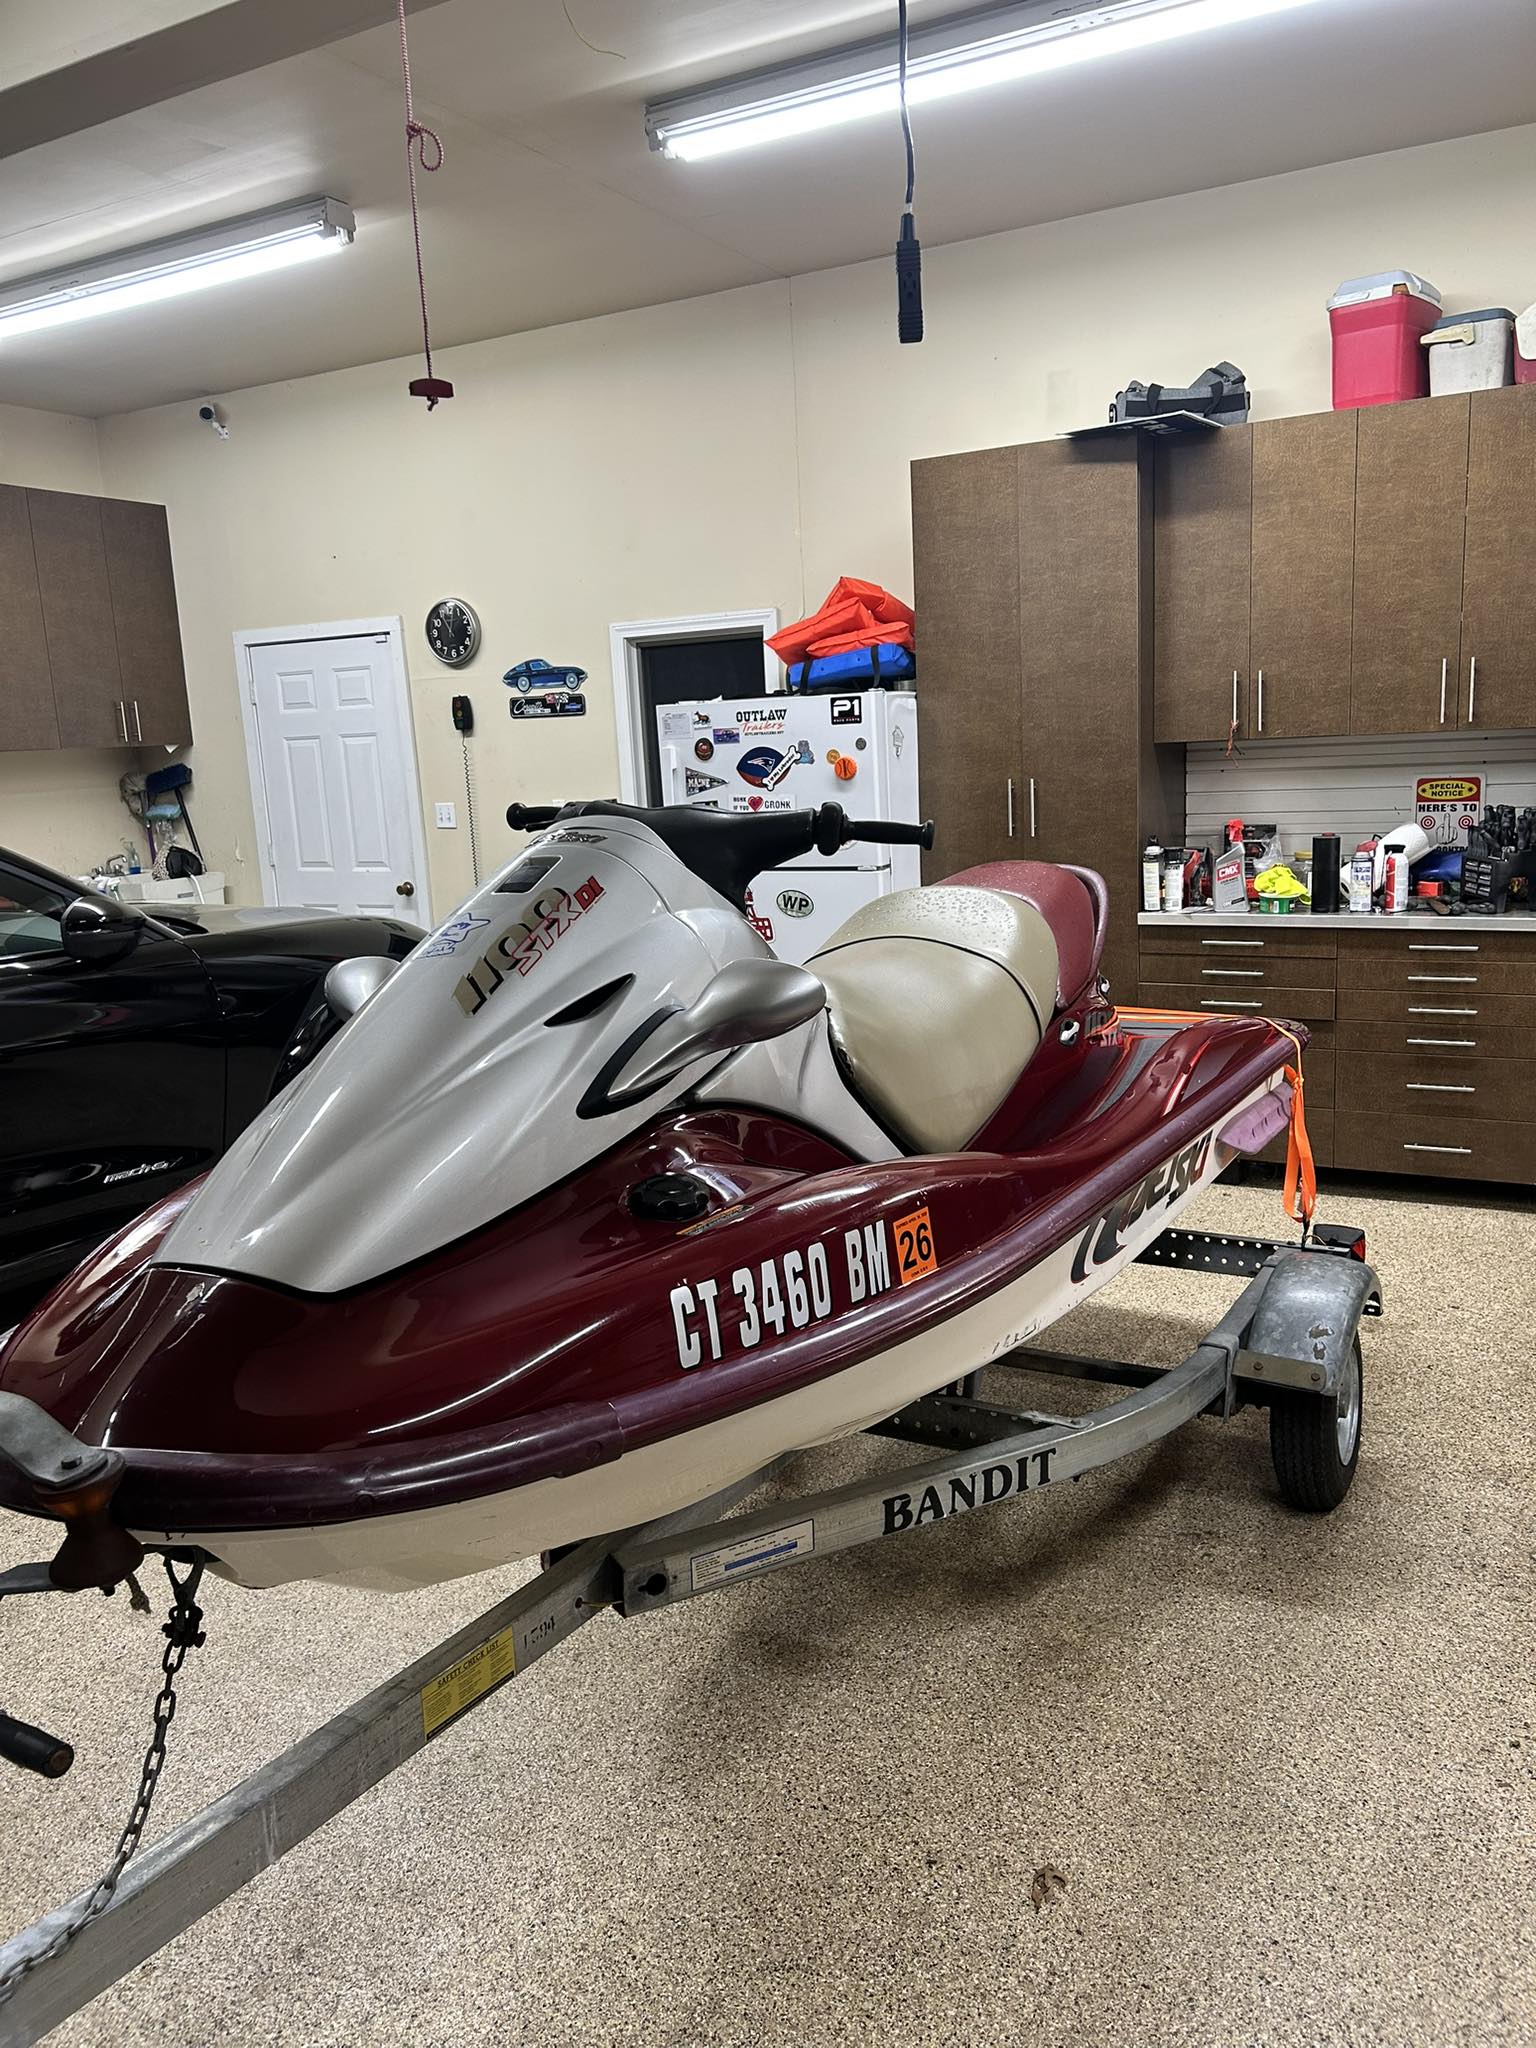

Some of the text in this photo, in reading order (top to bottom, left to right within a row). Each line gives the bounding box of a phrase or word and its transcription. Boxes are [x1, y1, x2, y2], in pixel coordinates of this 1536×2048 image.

[432, 628, 438, 638] 9
[466, 626, 472, 635] 3
[436, 640, 442, 649] 8
[464, 637, 470, 646] 4
[442, 646, 448, 655] 7
[451, 649, 457, 658] 6
[459, 646, 465, 655] 5
[832, 699, 860, 718] P1
[736, 709, 788, 723] OUTLAW
[742, 720, 784, 733] Trailers
[687, 777, 711, 788] MAINE
[1429, 783, 1466, 791] SPECIAL
[1431, 789, 1464, 797] NOTICE
[764, 800, 792, 810] GRONK
[1418, 803, 1477, 813] HERE'S TO
[1218, 864, 1239, 878] CMX
[573, 875, 608, 912] DI
[782, 894, 809, 911] WP
[511, 893, 583, 977] STX
[899, 1222, 932, 1272] 26
[669, 1219, 892, 1369] CT 3460 BM
[882, 1448, 1057, 1535] BANDIT
[437, 1639, 500, 1688] SAFETY CHECK LIST
